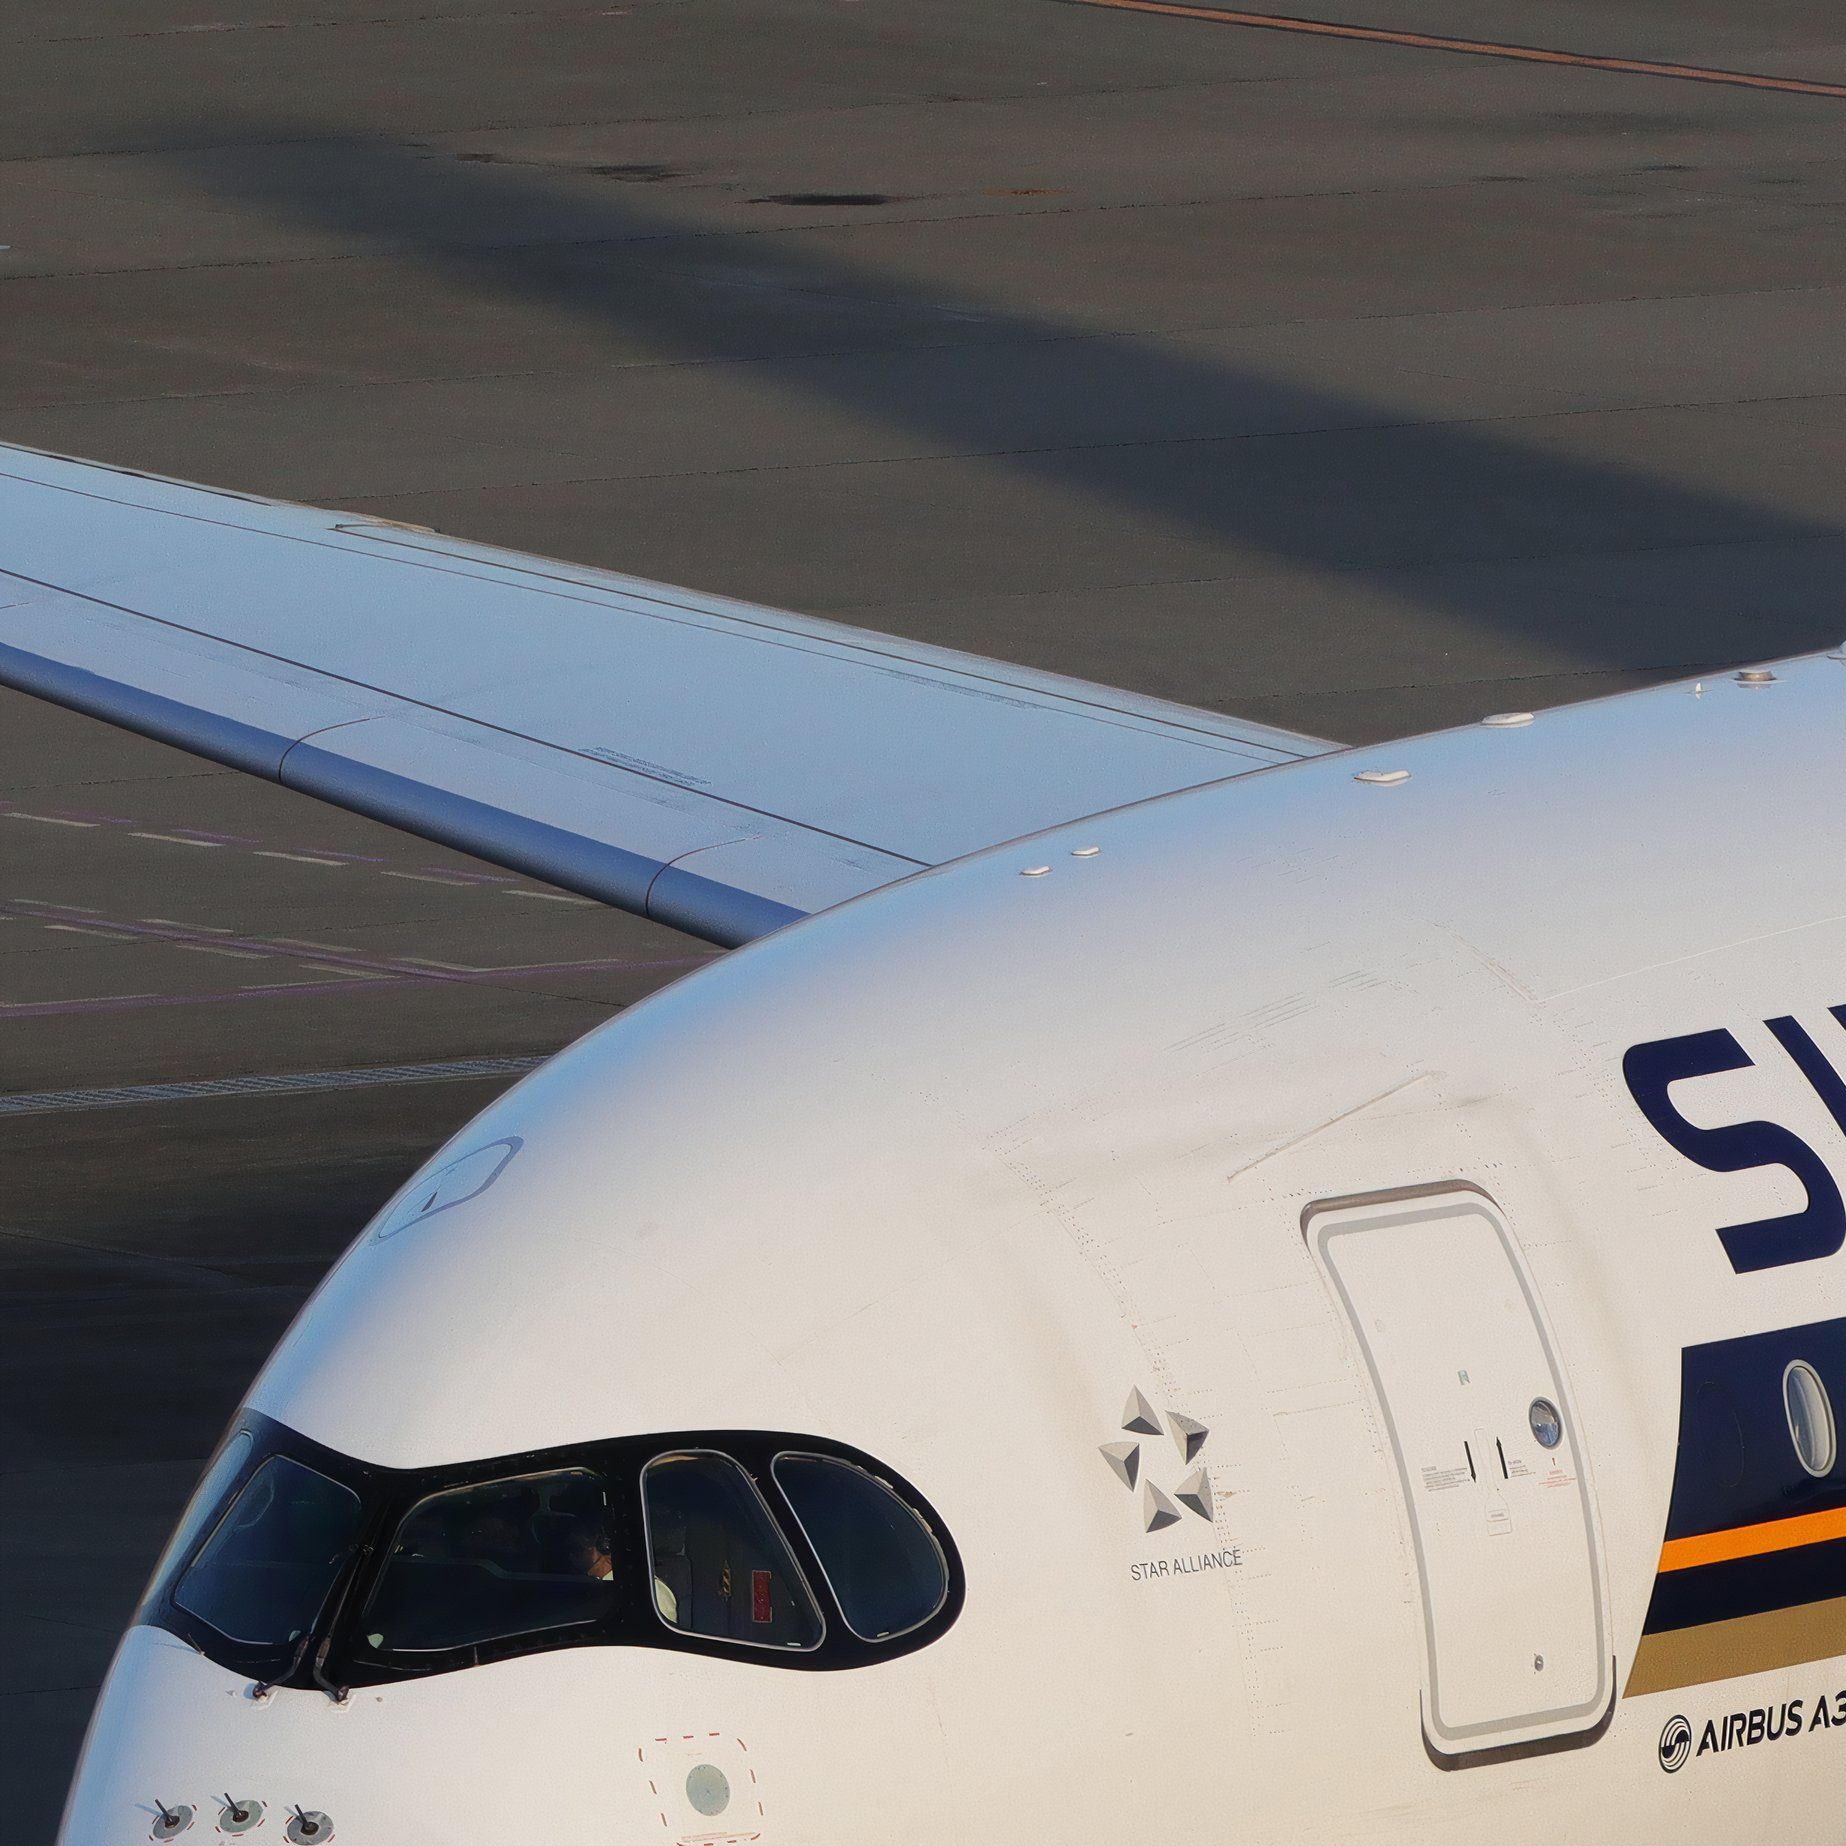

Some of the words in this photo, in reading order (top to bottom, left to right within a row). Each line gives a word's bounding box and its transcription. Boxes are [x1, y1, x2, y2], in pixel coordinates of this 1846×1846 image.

[1131, 1560, 1170, 1581] STAR
[1173, 1549, 1243, 1575] ALLIANCE
[1696, 1699, 1803, 1757] AIRBUS
